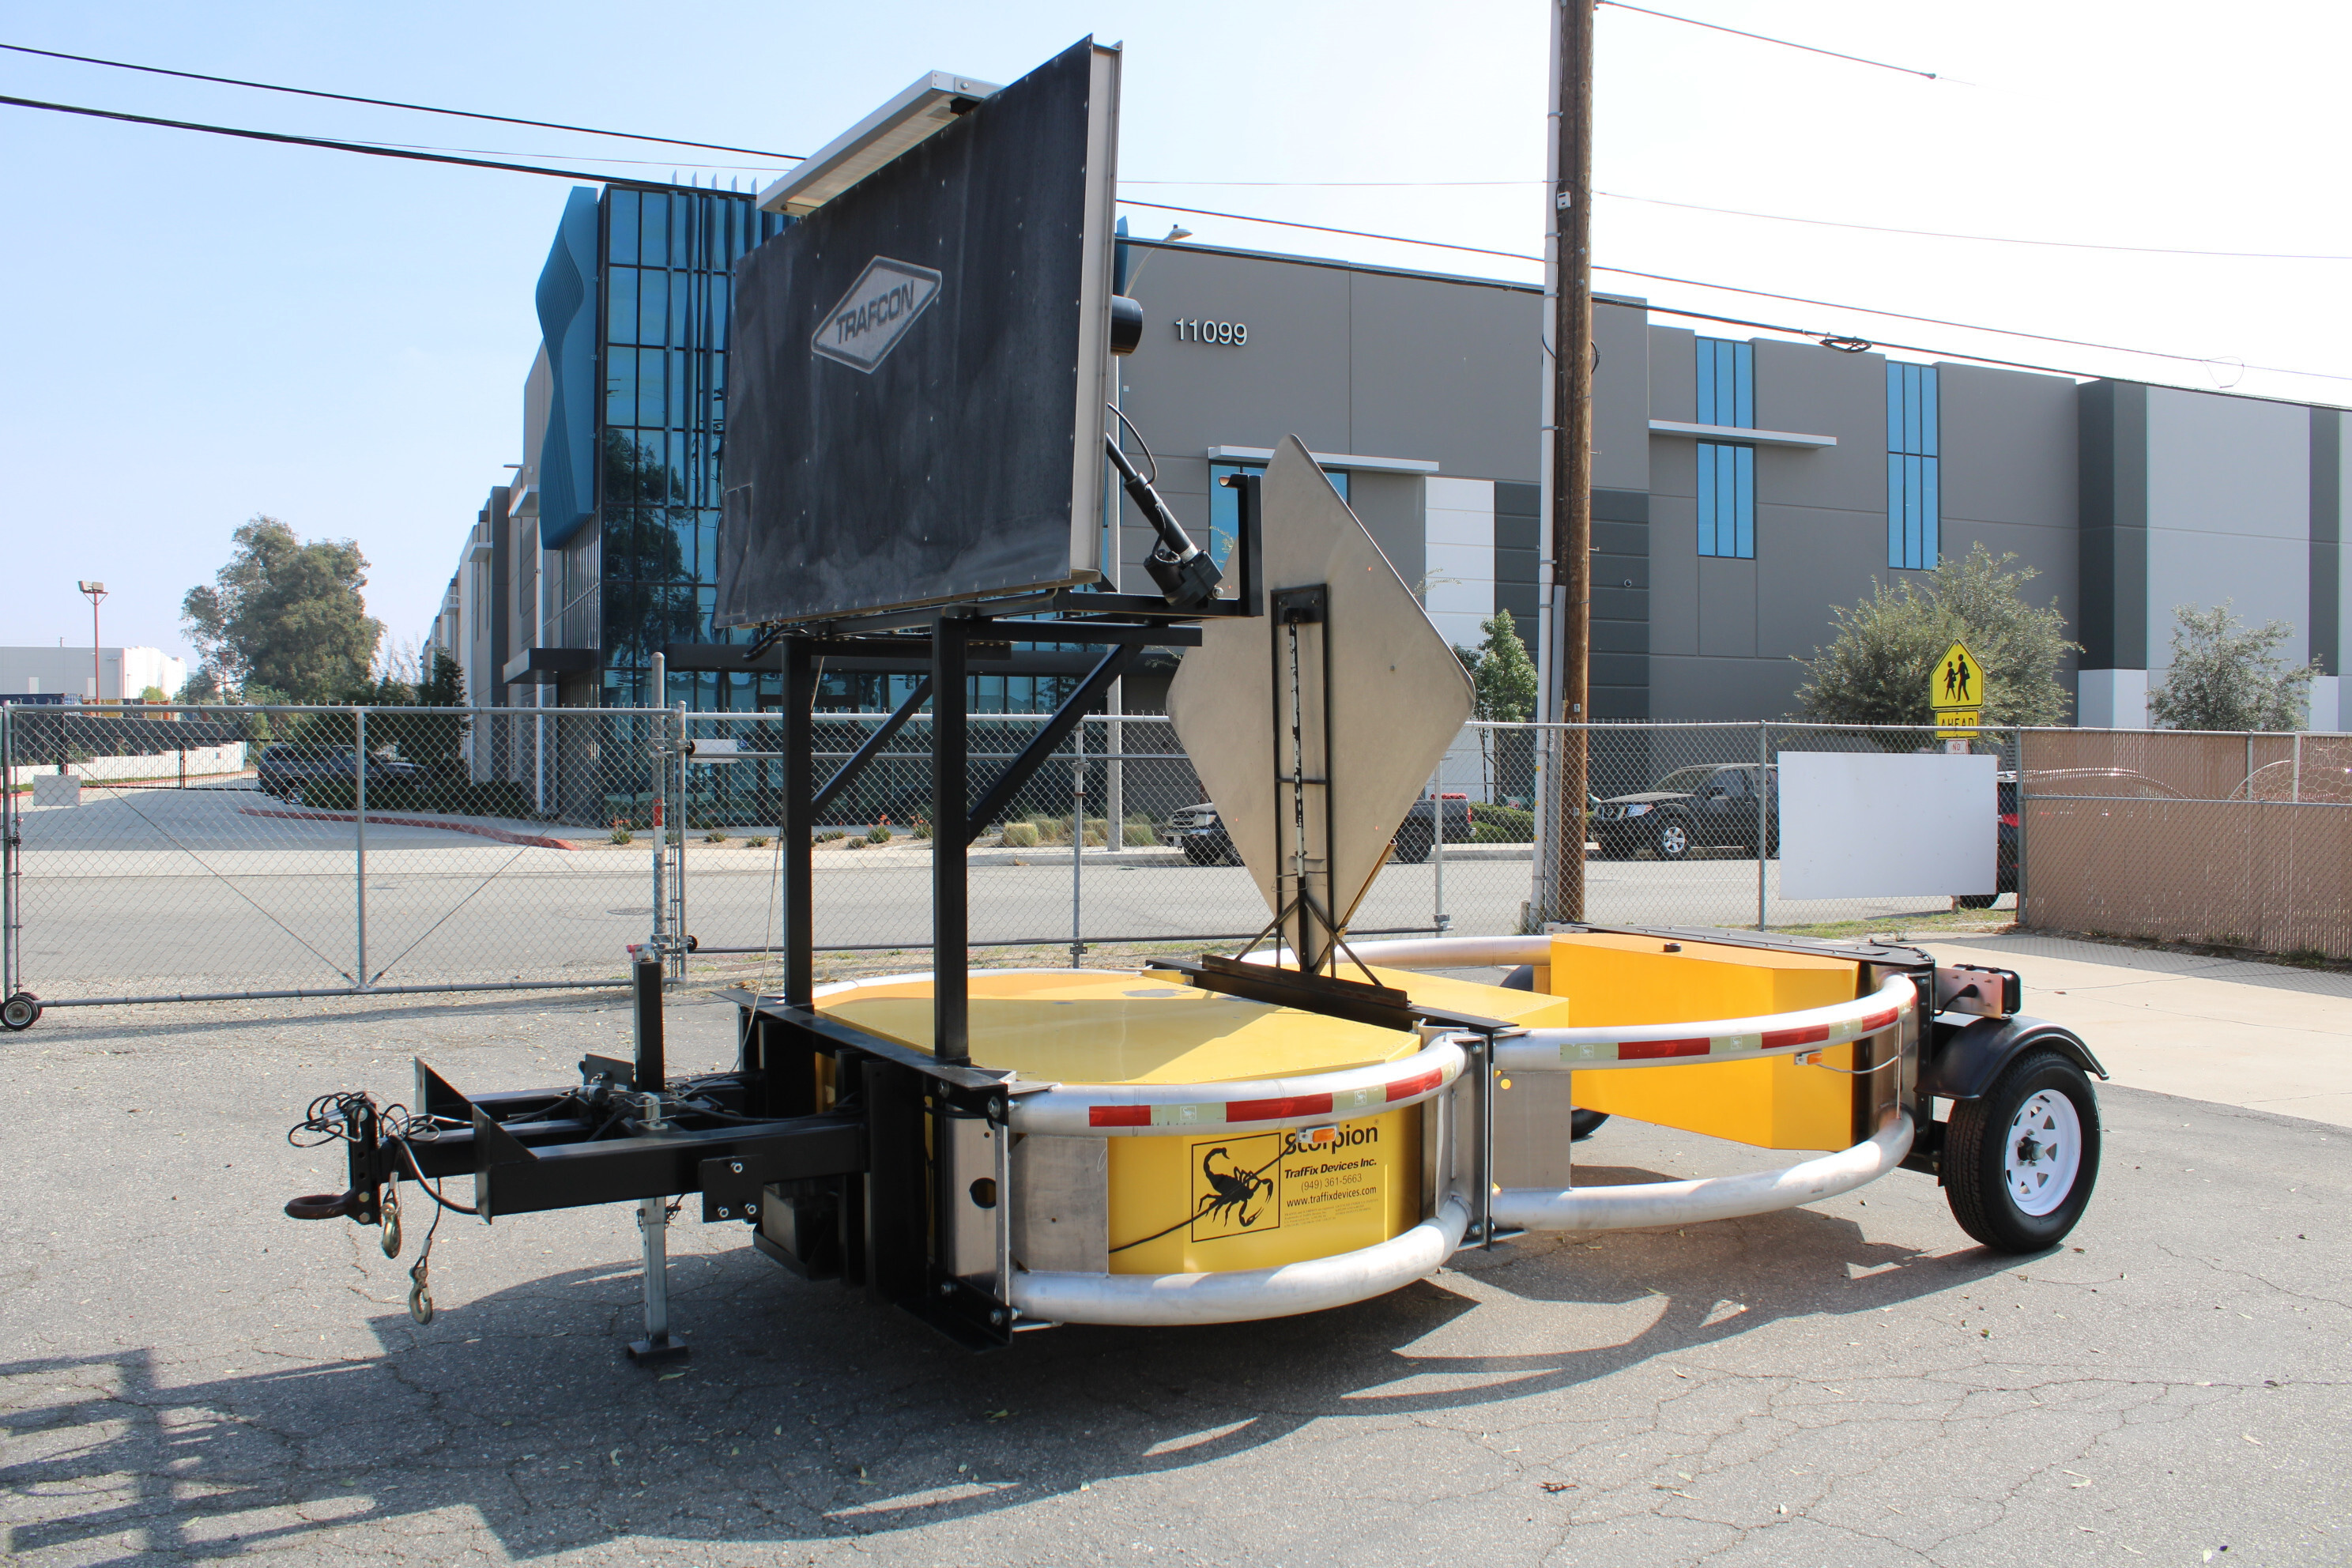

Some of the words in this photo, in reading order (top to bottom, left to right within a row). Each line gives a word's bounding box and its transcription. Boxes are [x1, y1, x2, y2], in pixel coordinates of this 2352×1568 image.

[836, 280, 914, 344] TRAFCON
[1175, 318, 1248, 346] 11099
[1284, 1165, 1318, 1178] TrafFix
[1321, 1161, 1359, 1174] Devices
[1360, 1158, 1377, 1167] Inc.
[1301, 1179, 1322, 1193] (949)
[1325, 1173, 1362, 1188] 361-5663
[1287, 1186, 1377, 1208] www.traffixdevices.com
